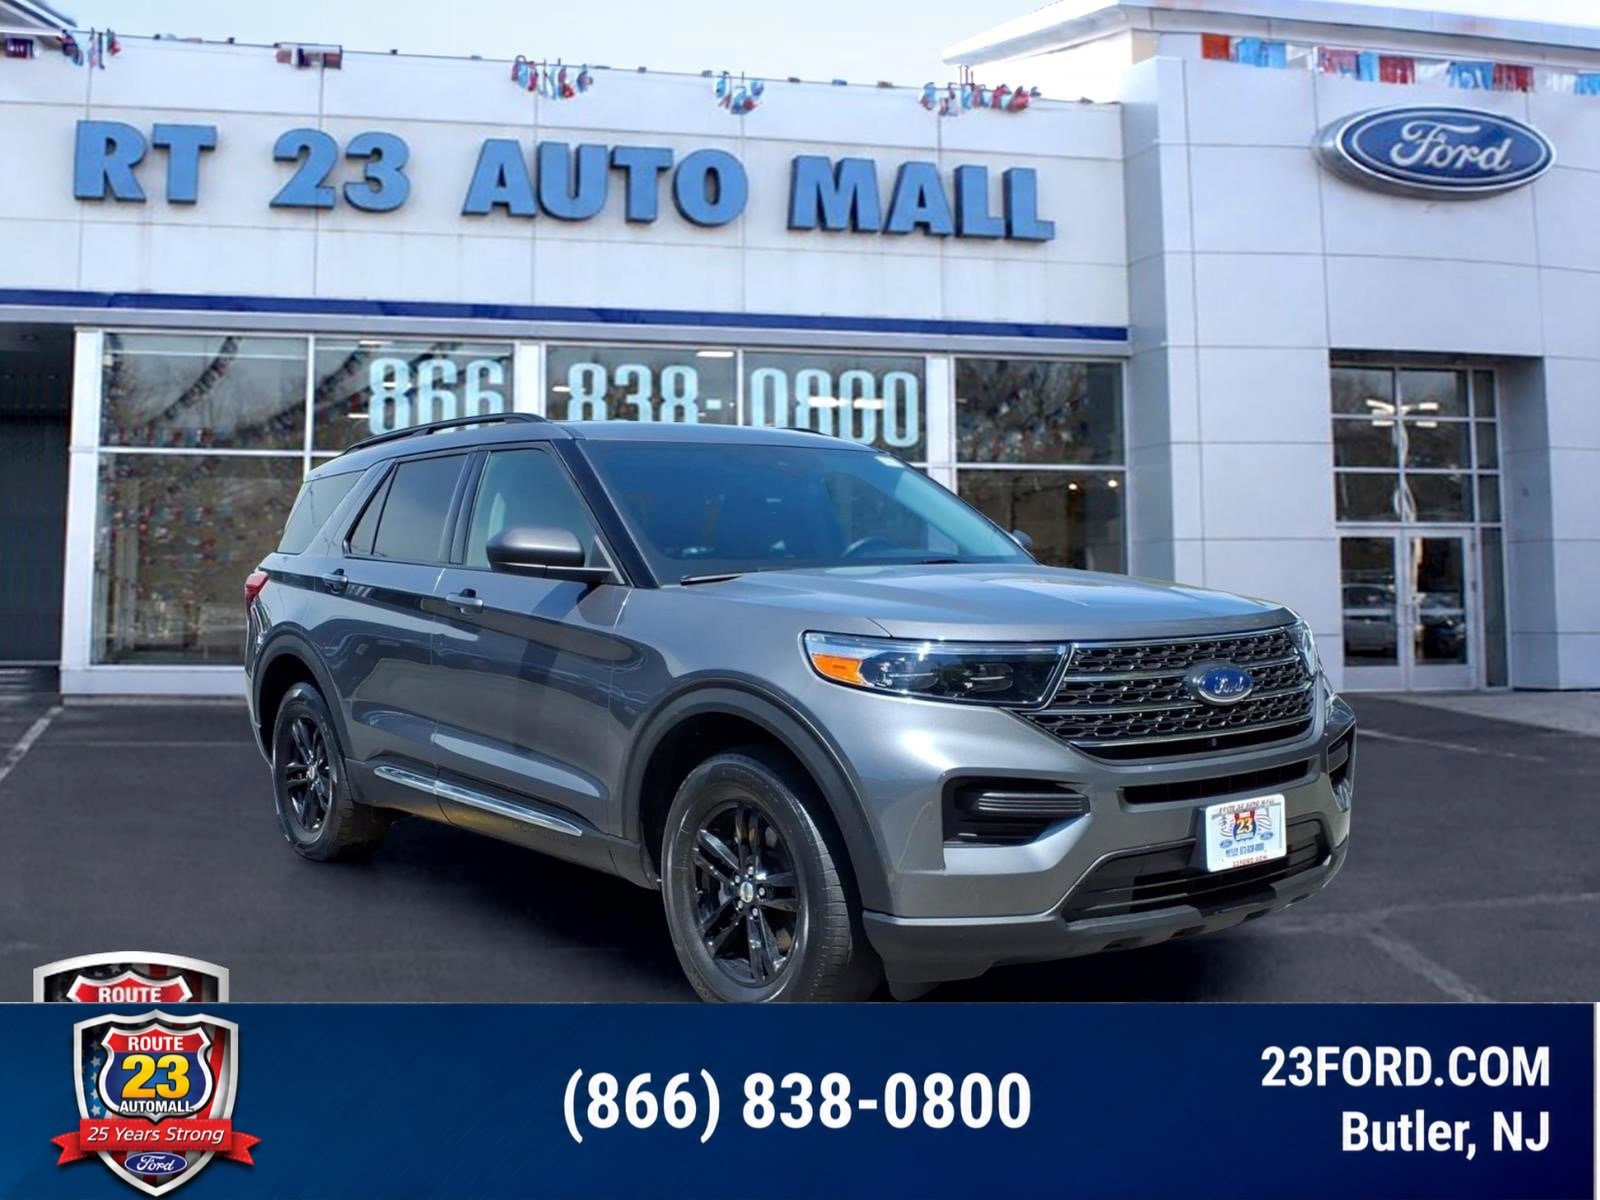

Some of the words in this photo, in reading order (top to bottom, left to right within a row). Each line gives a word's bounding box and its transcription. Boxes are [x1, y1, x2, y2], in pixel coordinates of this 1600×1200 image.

[1389, 120, 1512, 171] Ford
[74, 120, 217, 204] RT
[269, 128, 411, 213] 23
[461, 138, 749, 227] AUTO
[787, 155, 1055, 241] MALL
[369, 357, 504, 436] 866
[1236, 816, 1253, 834] 23
